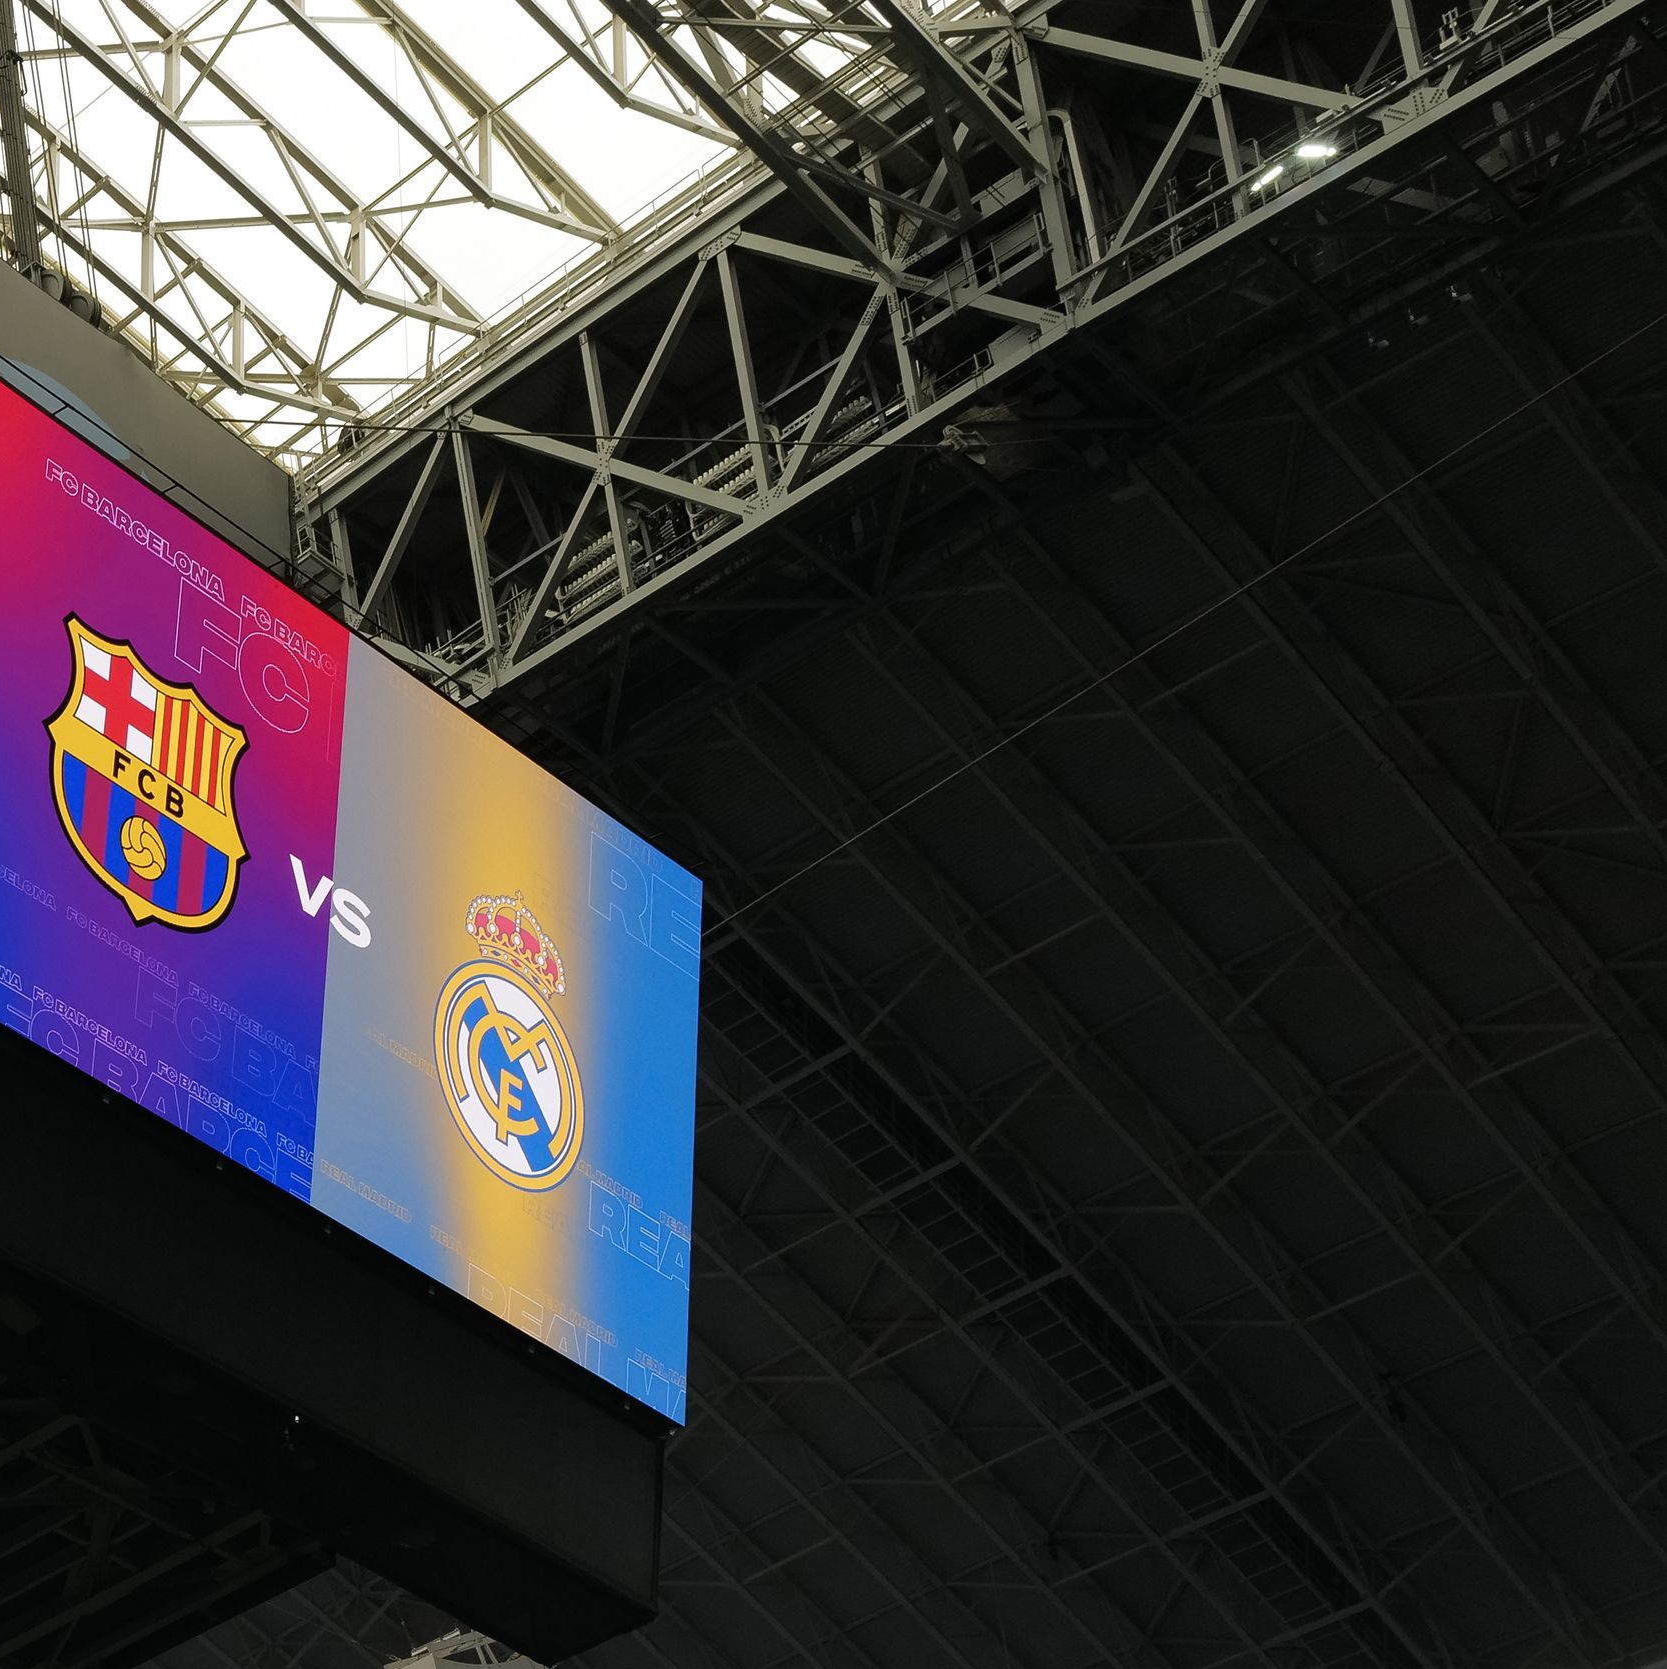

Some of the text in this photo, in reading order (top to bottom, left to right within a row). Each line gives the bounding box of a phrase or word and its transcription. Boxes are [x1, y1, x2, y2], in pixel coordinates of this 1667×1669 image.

[45, 457, 78, 498] FC
[80, 484, 227, 600] BARCELONA
[241, 594, 273, 631] FC
[111, 755, 184, 818] FCB
[33, 986, 54, 1009] FC
[55, 998, 148, 1066] BARCELONA
[157, 1059, 178, 1081] FC
[178, 1071, 267, 1137] BARCELONA
